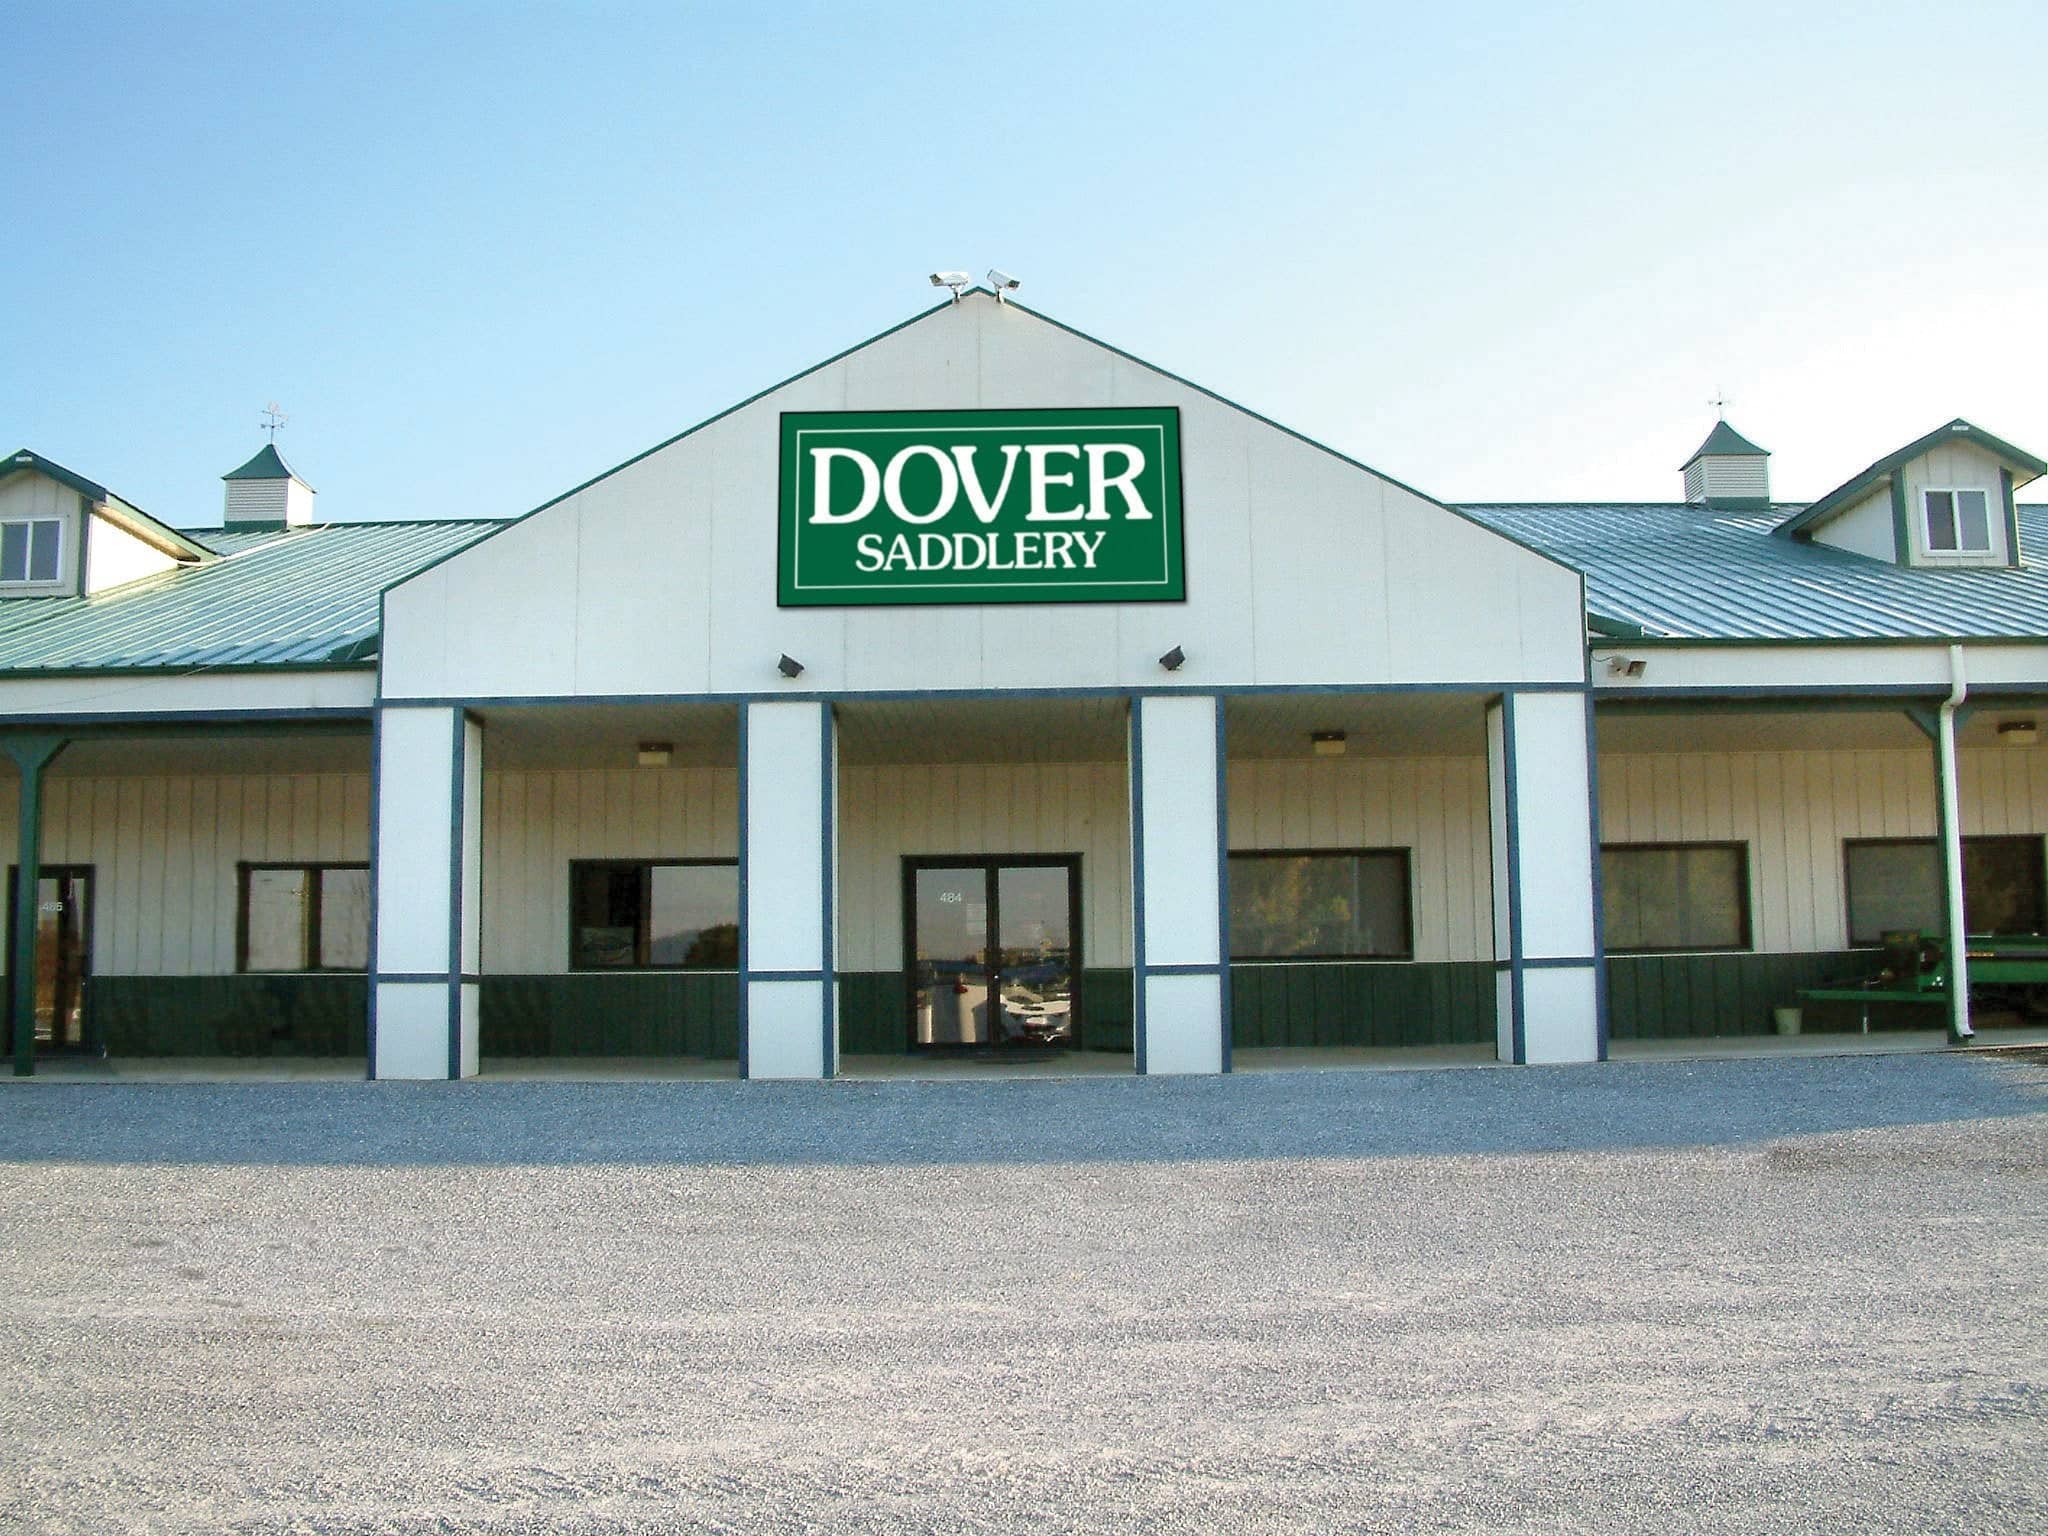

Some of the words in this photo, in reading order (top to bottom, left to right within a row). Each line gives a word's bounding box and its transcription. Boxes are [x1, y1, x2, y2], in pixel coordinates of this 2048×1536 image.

[809, 443, 1152, 524] DOVER
[856, 531, 1106, 571] SADDLERY
[939, 891, 961, 903] 484
